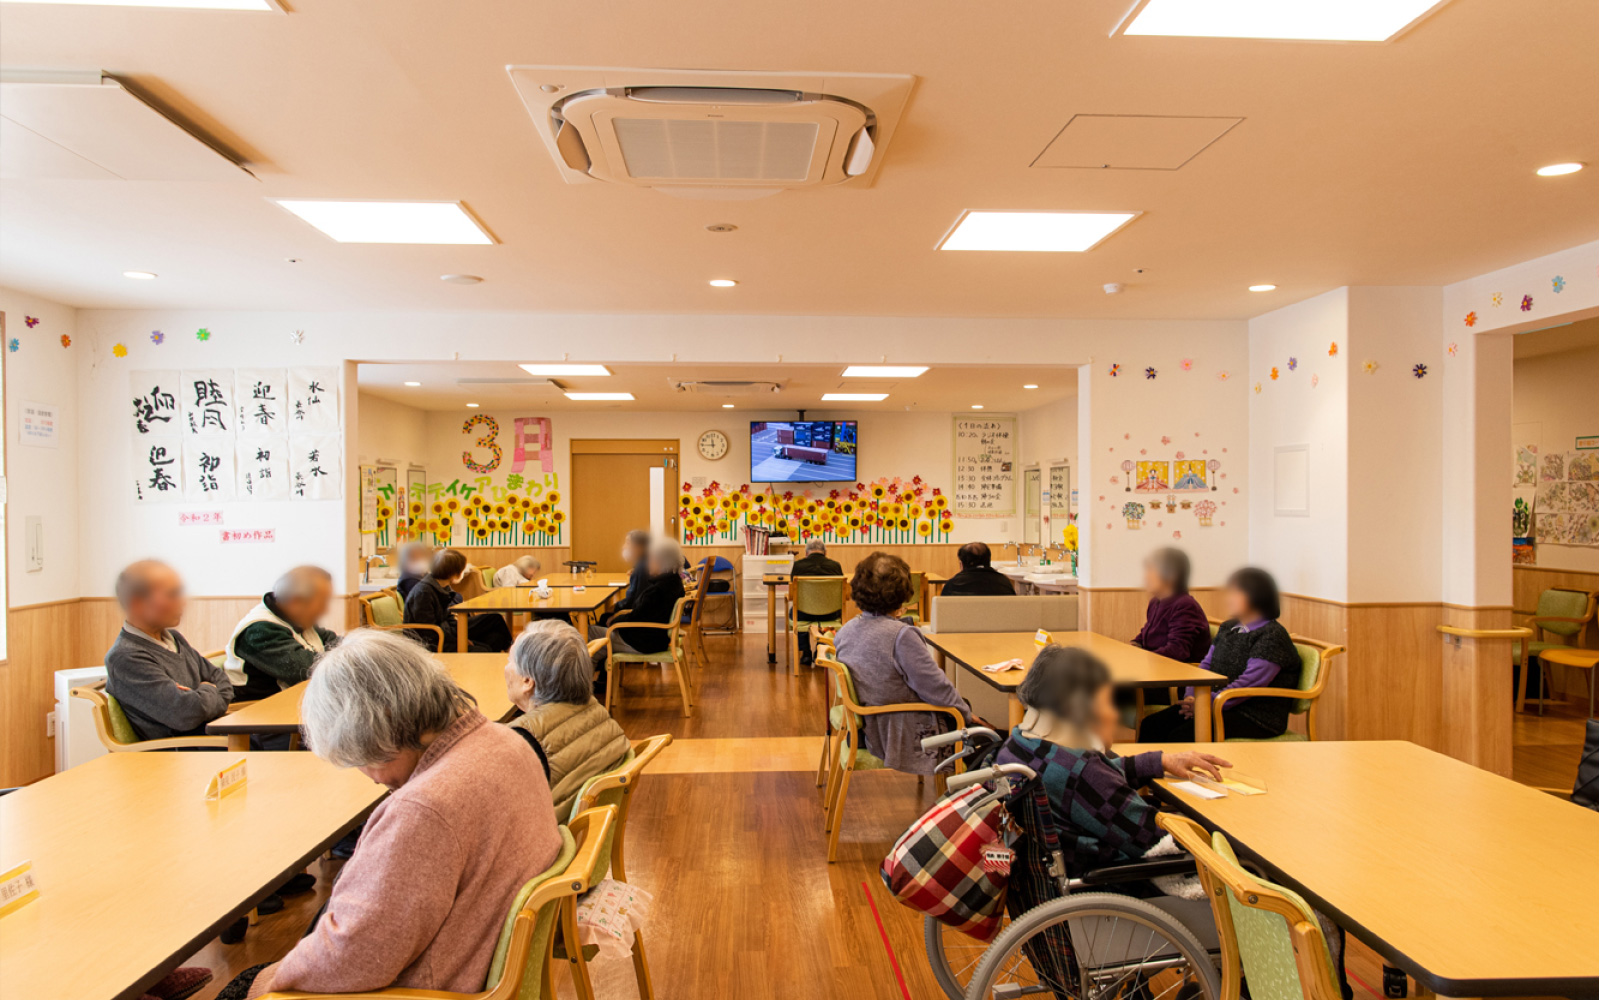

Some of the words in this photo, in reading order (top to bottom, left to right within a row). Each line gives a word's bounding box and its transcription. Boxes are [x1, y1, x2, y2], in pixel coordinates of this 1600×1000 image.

[253, 381, 276, 425] 迎春
[307, 381, 325, 405] 水仙
[463, 414, 553, 474] 3月
[199, 452, 220, 492] 初詣
